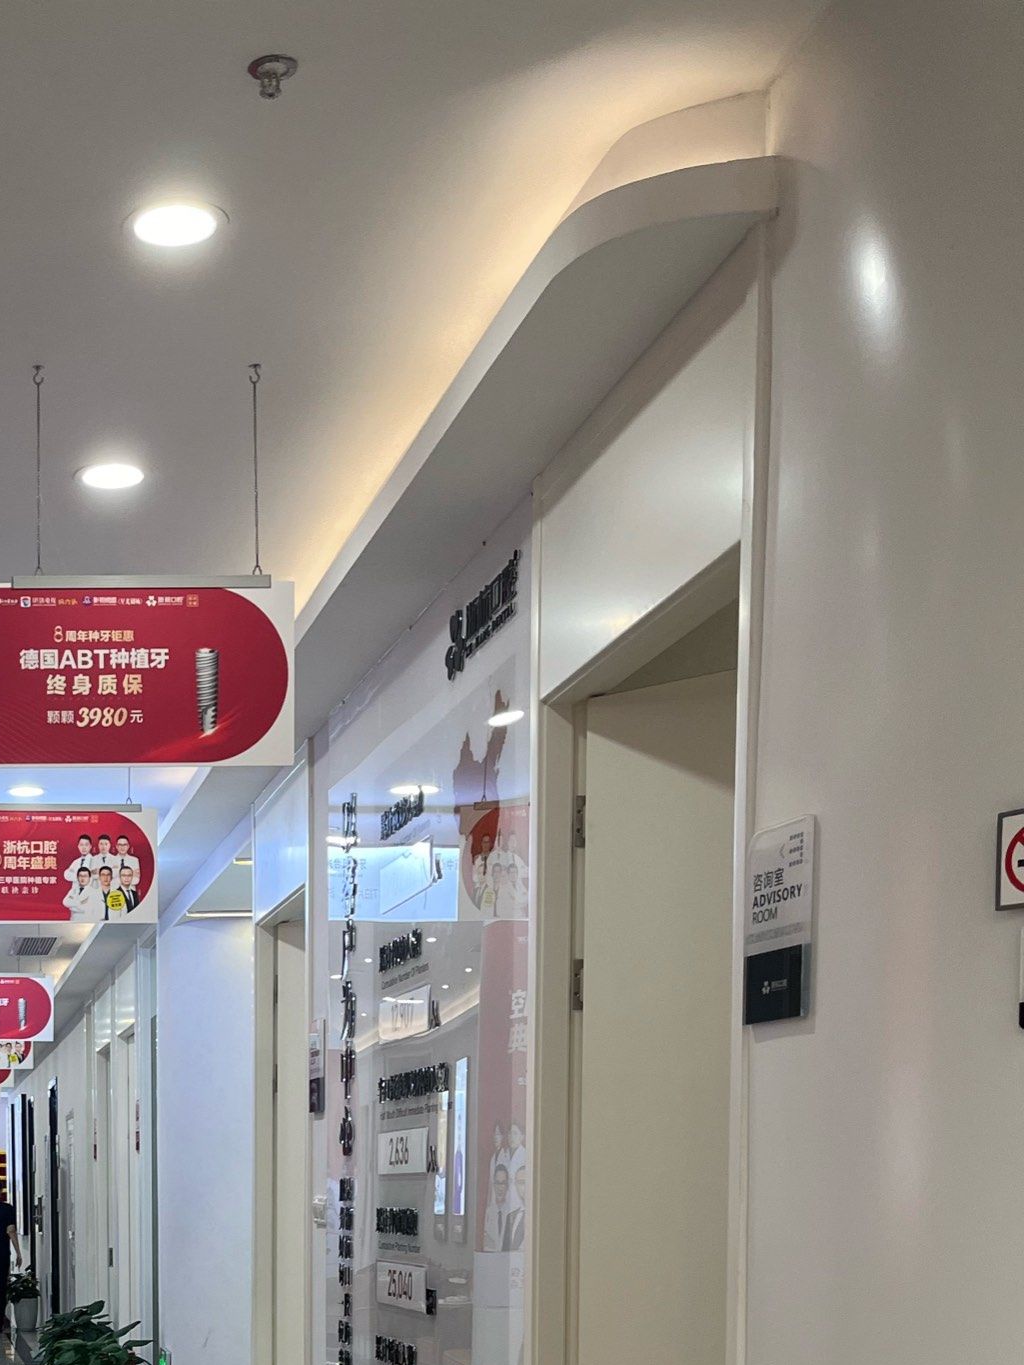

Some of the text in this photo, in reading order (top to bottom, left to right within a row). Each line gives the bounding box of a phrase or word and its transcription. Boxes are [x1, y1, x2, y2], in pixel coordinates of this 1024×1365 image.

[19, 648, 169, 670] 德国ABT种植牙
[46, 674, 143, 695] 终身质保
[47, 707, 143, 728] 颗颗3980元
[3, 840, 57, 855] 浙杭口腔
[3, 856, 57, 870] 周年盛典
[753, 867, 784, 893] 咨询室
[752, 884, 803, 909] ADVISORY
[752, 907, 777, 924] ROOM
